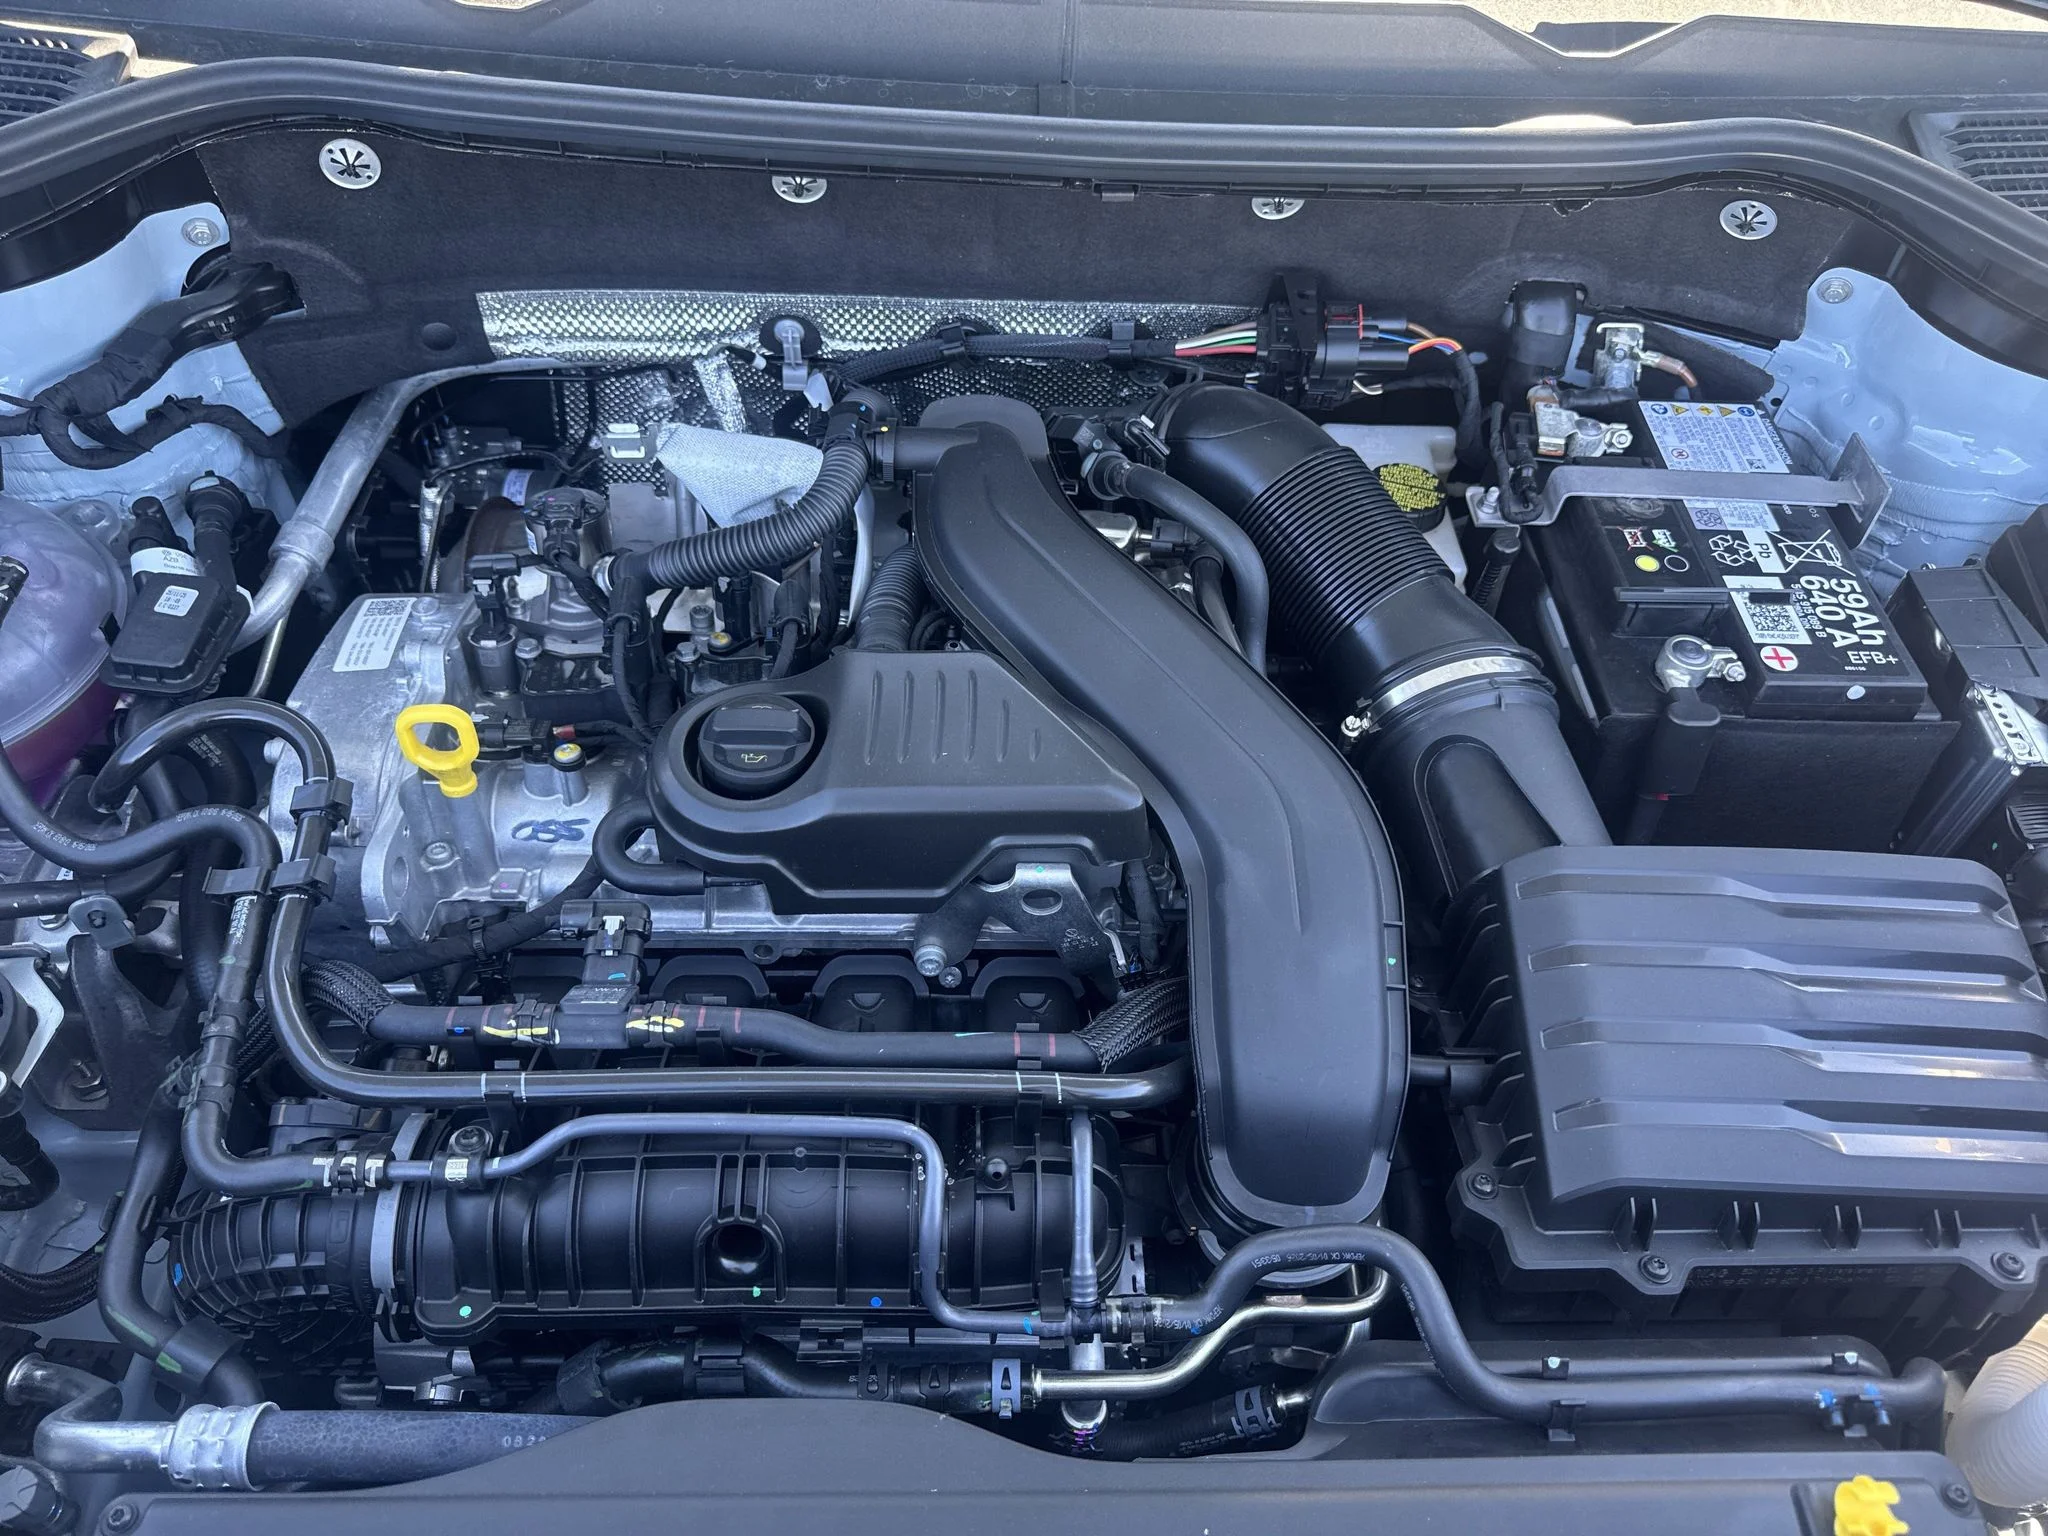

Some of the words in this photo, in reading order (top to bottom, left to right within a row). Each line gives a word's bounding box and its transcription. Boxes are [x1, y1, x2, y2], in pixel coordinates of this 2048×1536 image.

[1754, 543, 1771, 559] Pb
[1800, 601, 1815, 614] 915
[1800, 575, 1847, 621] 640
[1826, 627, 1860, 648] A
[1830, 578, 1887, 646] 59Ah
[1807, 615, 1824, 630] 089
[1847, 650, 1899, 665] EFB+
